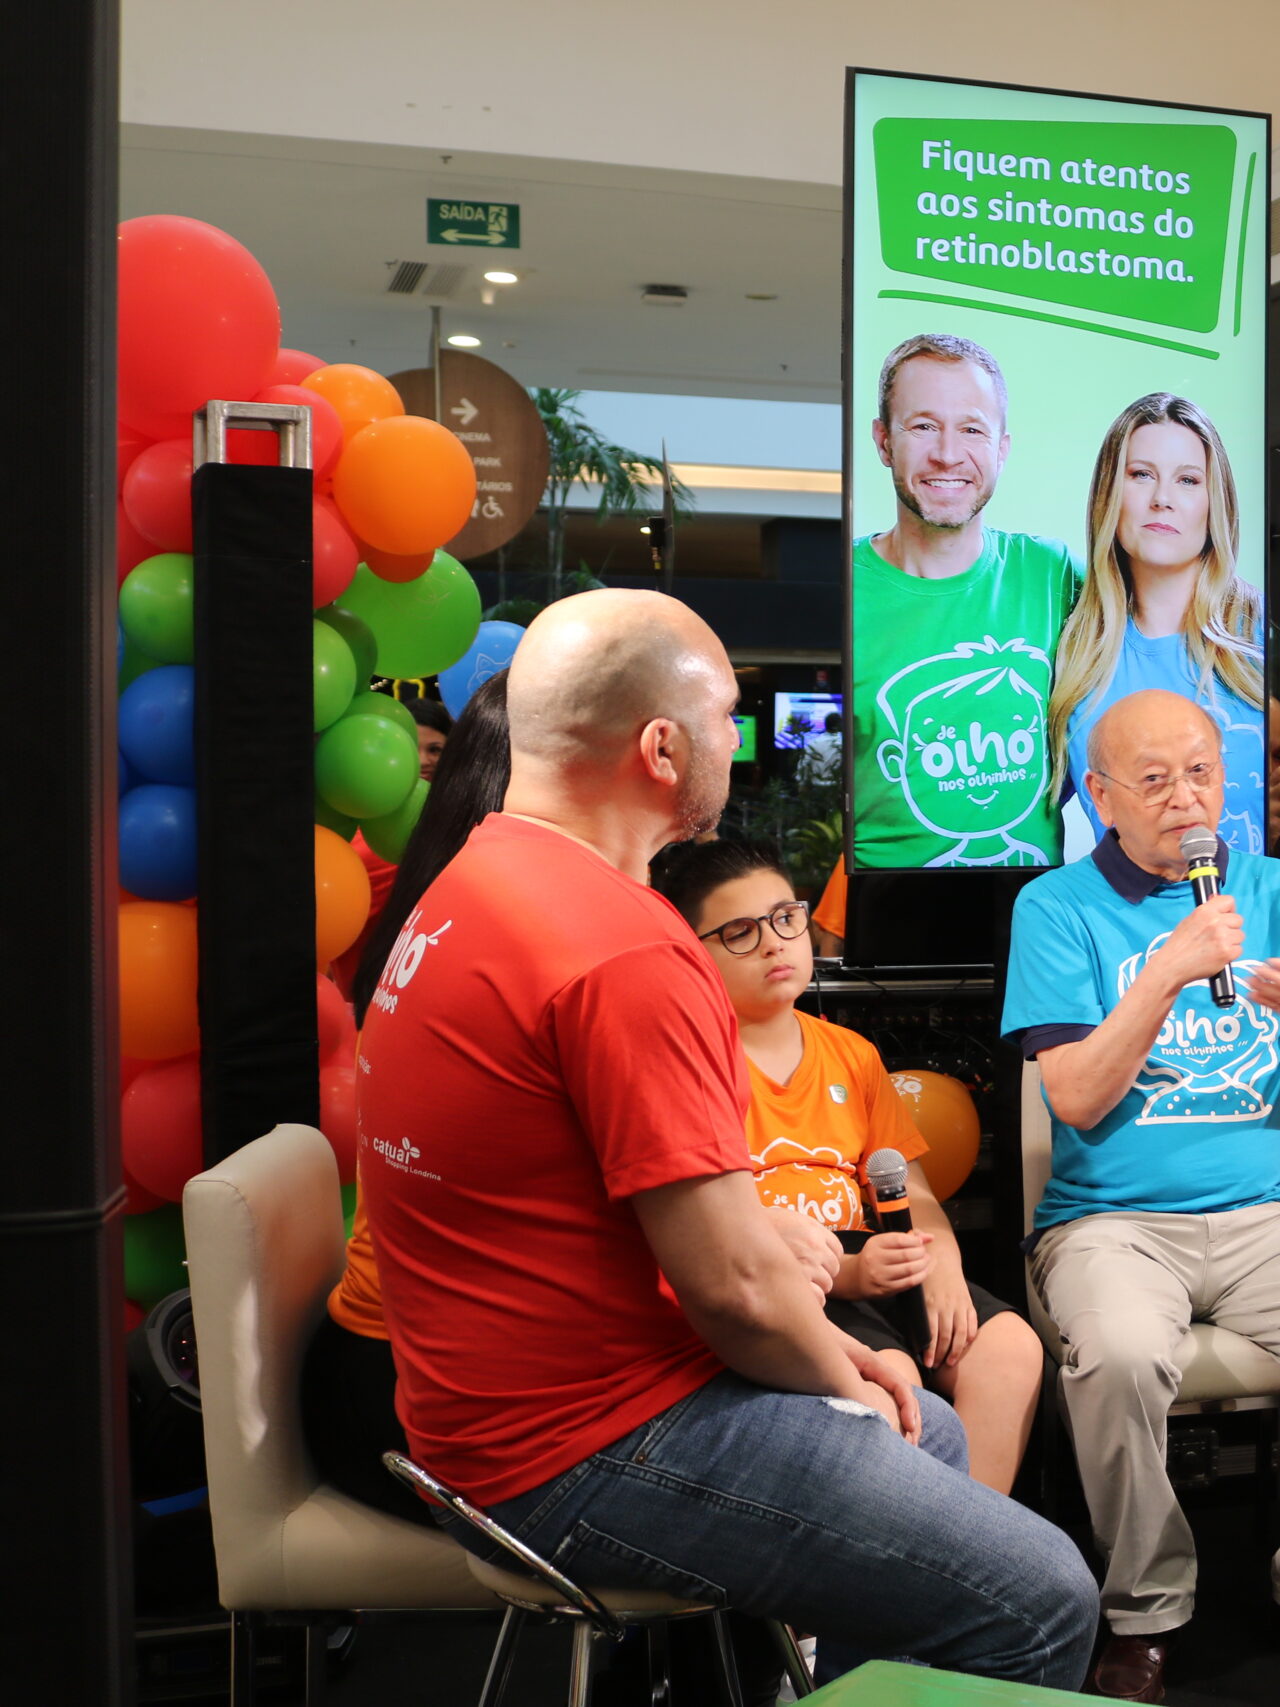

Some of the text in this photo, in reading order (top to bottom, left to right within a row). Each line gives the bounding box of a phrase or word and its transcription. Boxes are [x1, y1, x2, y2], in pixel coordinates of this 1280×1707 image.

[921, 139, 1191, 195] Fiquem atentos
[439, 202, 486, 221] SAÍDA
[916, 190, 1194, 239] aos sintomas do
[915, 233, 1195, 282] retinoblastoma.
[937, 724, 957, 741] de
[938, 766, 1027, 793] nos olhinhos
[1161, 1043, 1234, 1057] nos olhinhos
[409, 1165, 442, 1181] Londrina
